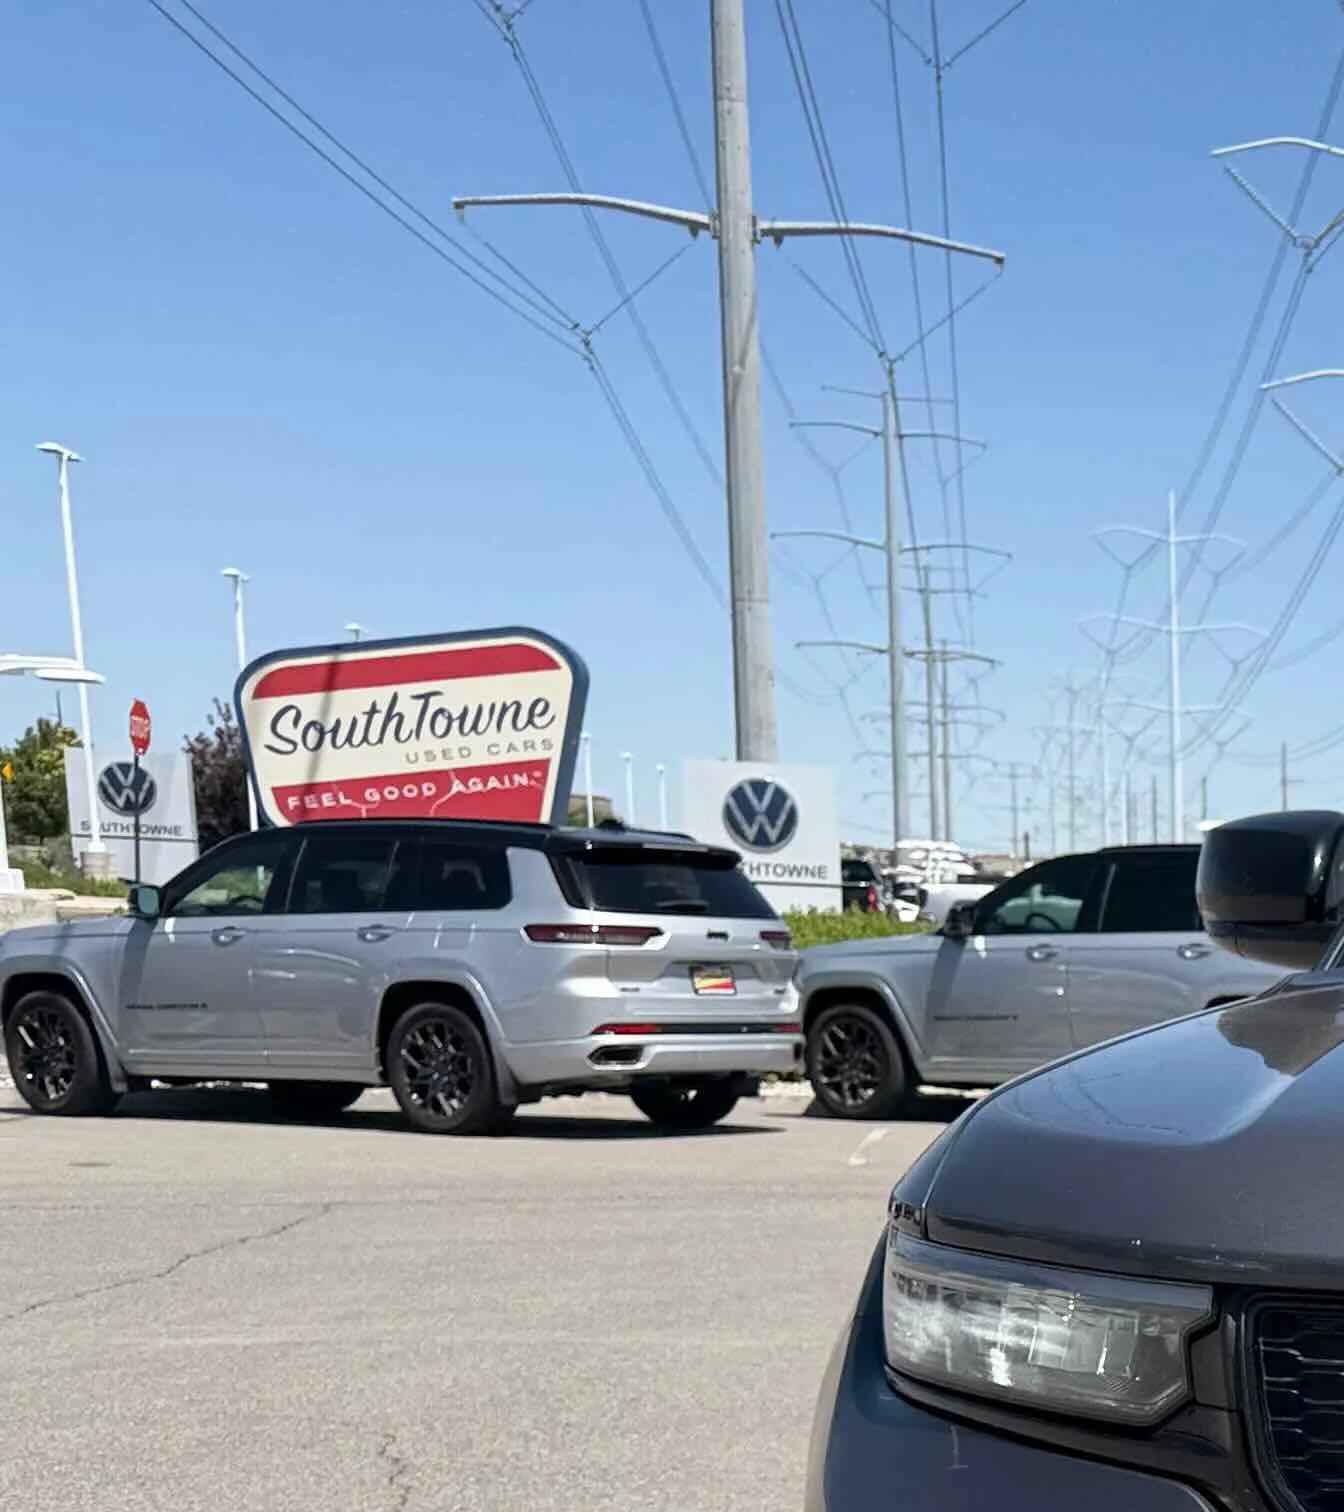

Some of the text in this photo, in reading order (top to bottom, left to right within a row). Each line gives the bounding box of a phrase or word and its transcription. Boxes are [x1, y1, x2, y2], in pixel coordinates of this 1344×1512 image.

[264, 690, 556, 755] SouthTowne
[405, 738, 554, 764] USED CARS
[287, 793, 353, 810] FEEL
[363, 782, 438, 802] GOOD
[80, 820, 182, 836] SUTHOWNE
